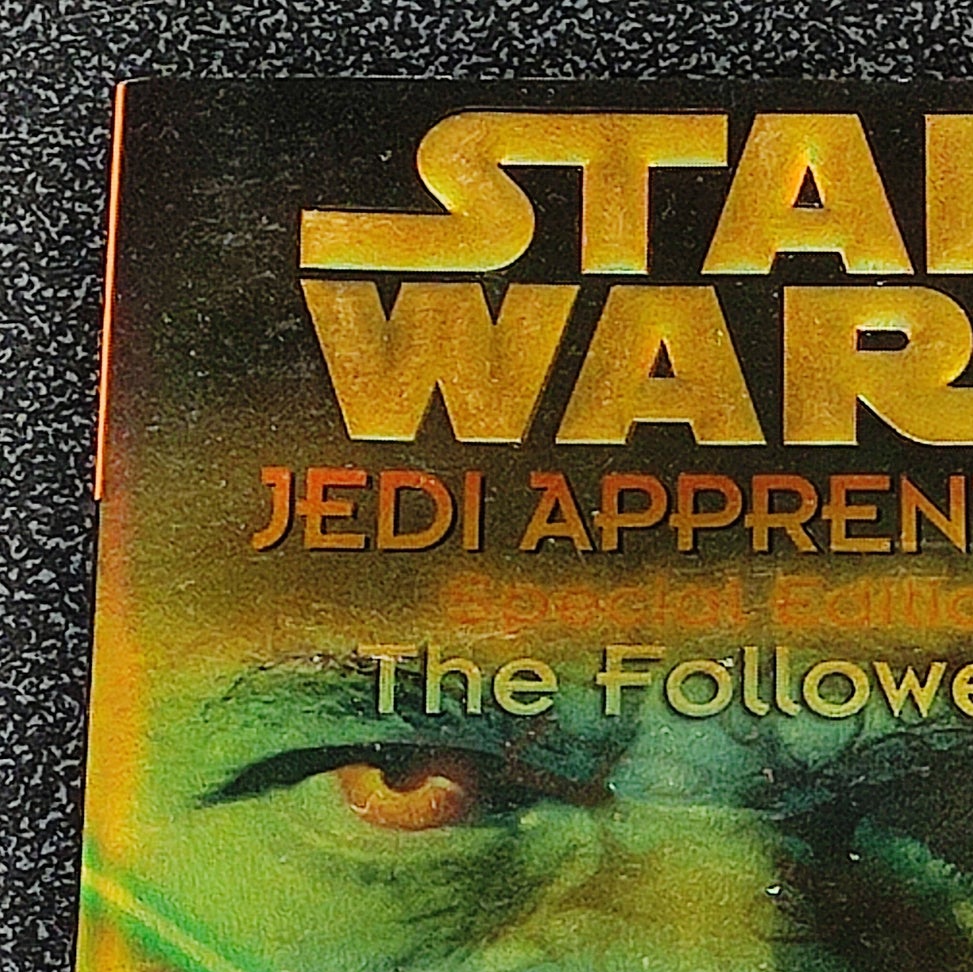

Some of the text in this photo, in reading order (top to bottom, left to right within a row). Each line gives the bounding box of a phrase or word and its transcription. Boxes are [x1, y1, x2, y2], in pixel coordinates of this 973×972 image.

[252, 466, 481, 553] JEDI
[445, 572, 742, 638] Special
[357, 643, 556, 717] The
